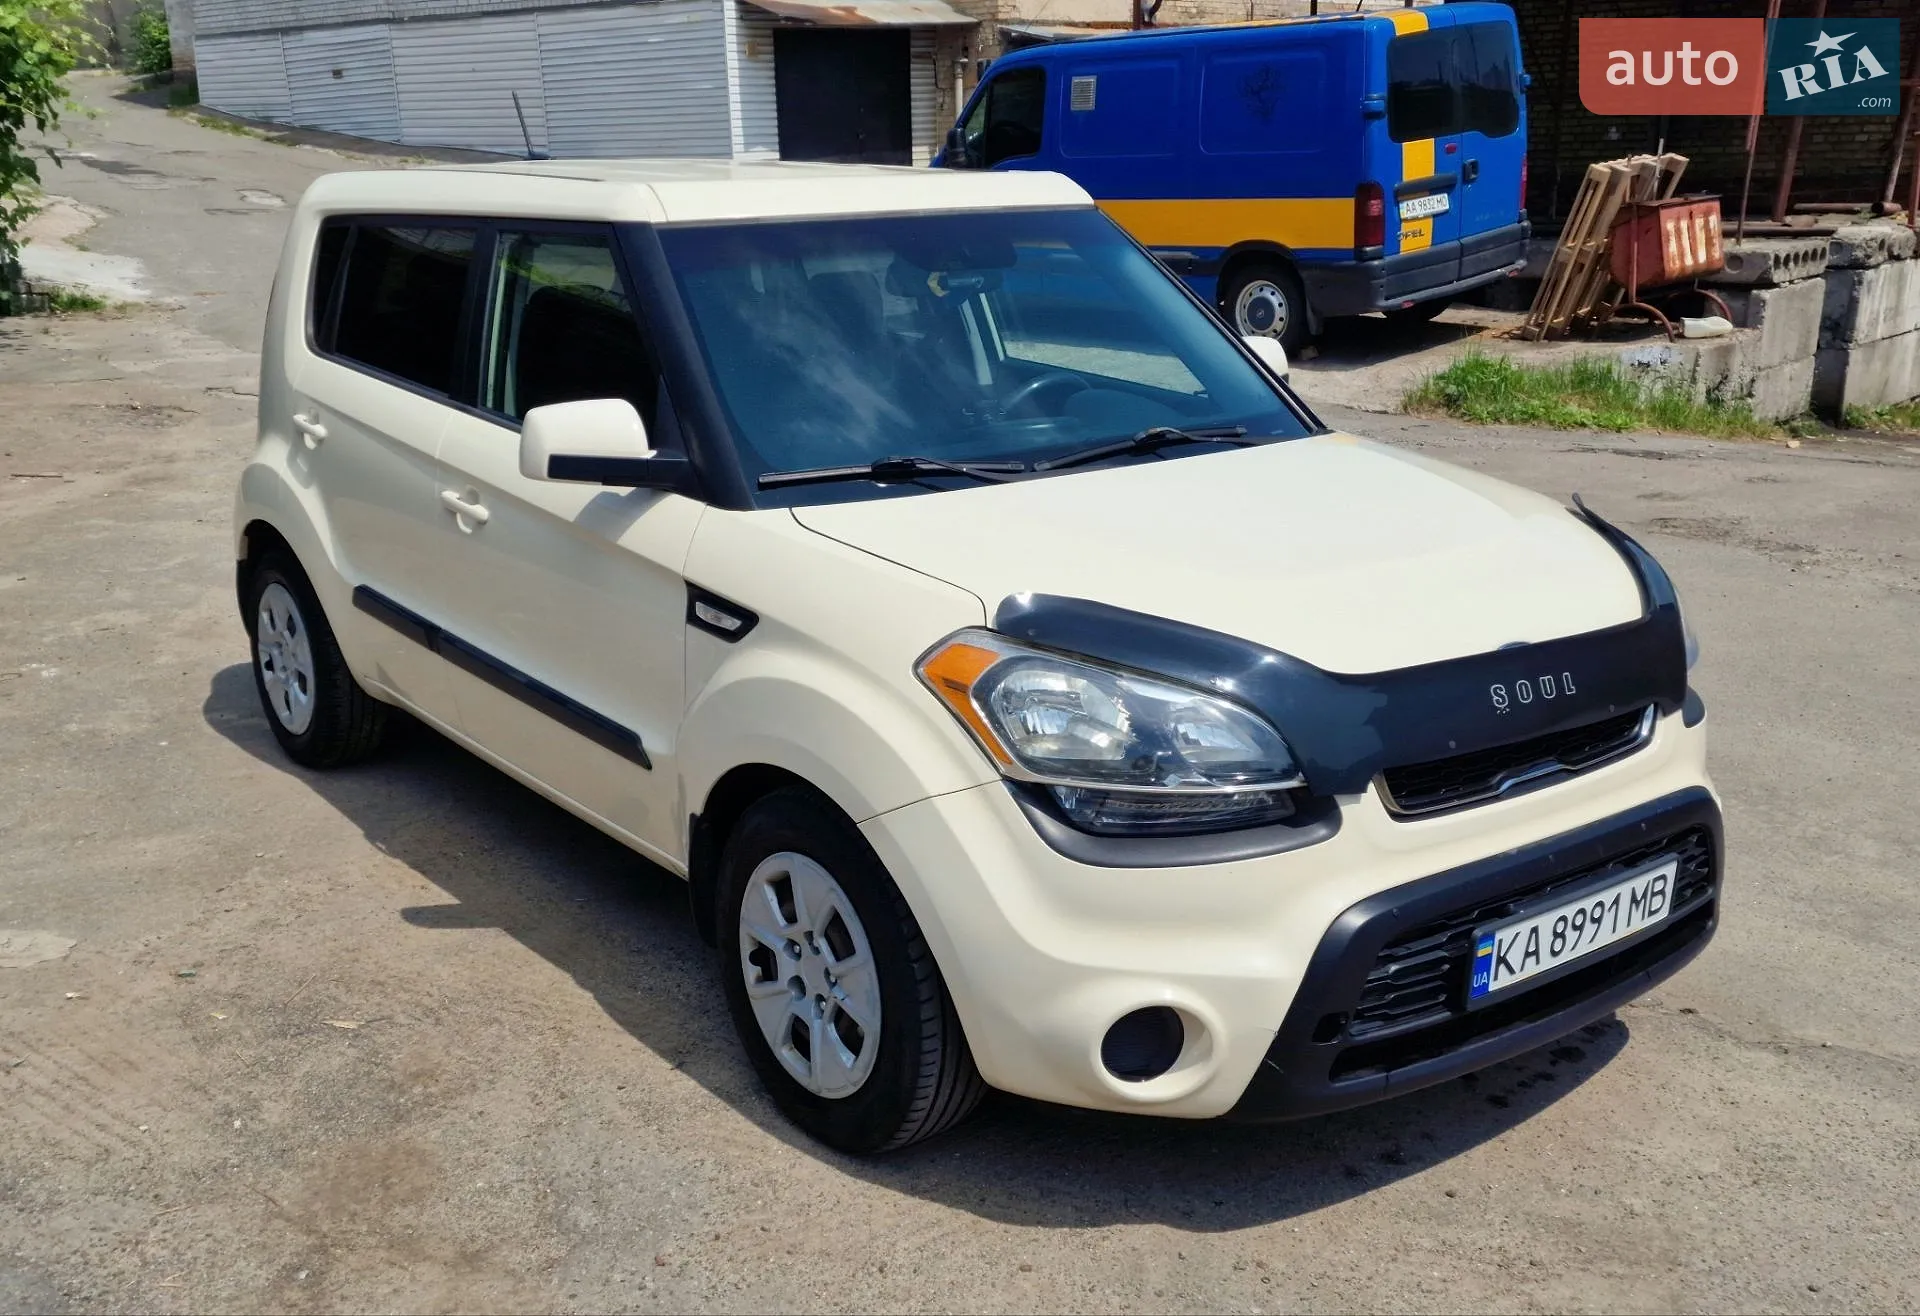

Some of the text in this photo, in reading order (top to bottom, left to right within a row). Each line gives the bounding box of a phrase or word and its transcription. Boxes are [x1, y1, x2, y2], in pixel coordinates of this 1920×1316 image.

[1490, 671, 1576, 708] SOUL
[1493, 873, 1669, 982] KA 8991 MB
[1472, 974, 1488, 988] UA
